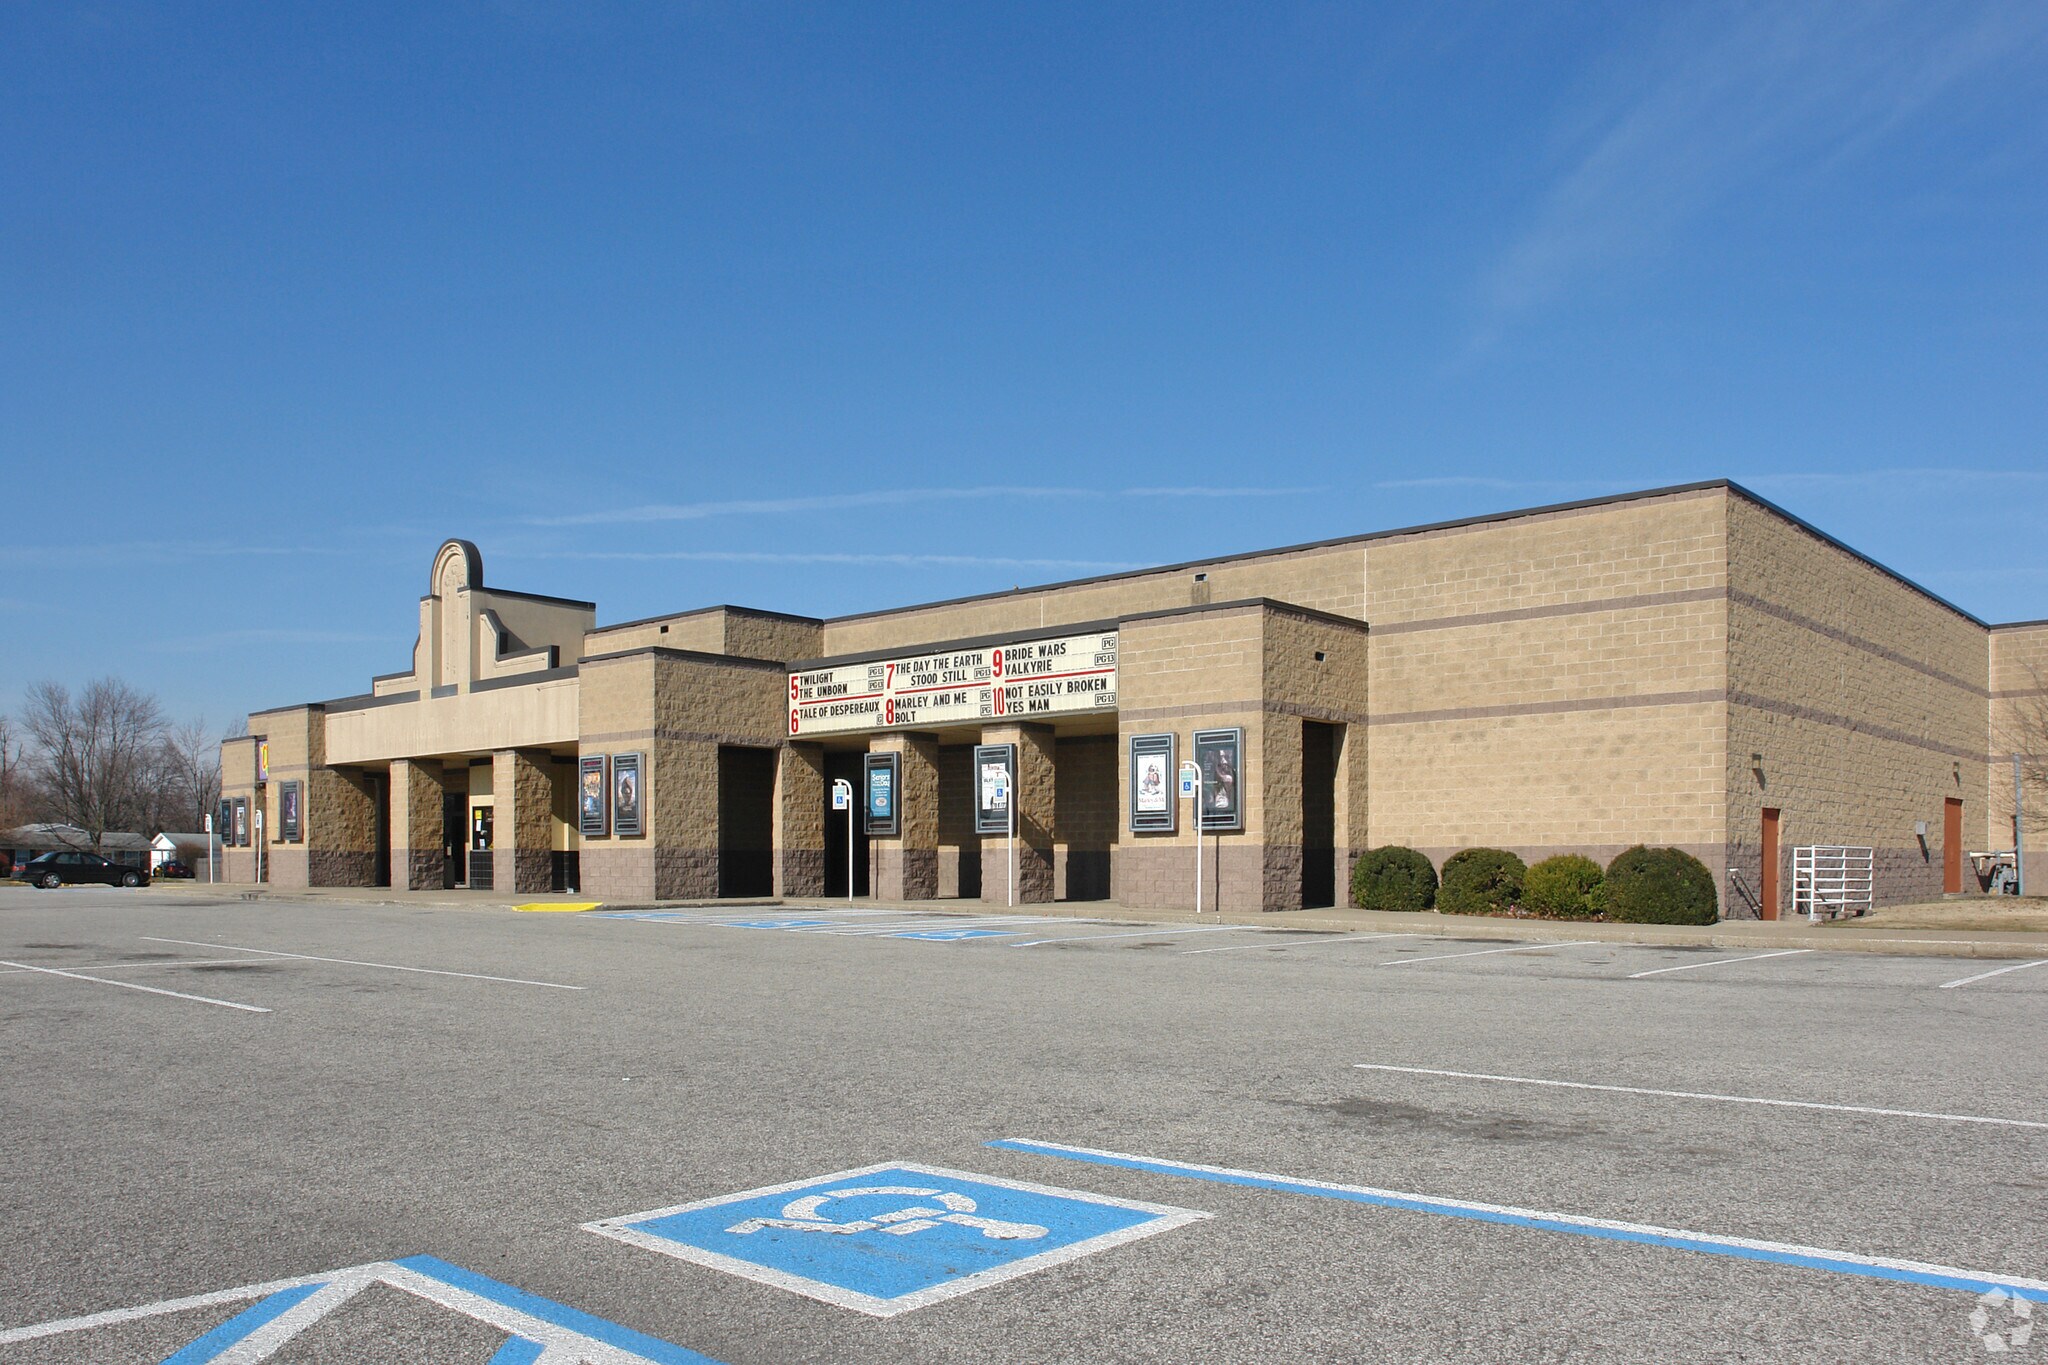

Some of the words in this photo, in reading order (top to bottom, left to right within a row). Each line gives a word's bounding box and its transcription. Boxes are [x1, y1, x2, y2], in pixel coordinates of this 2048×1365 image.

[1103, 639, 1114, 648] PG
[886, 663, 895, 689] 7
[896, 662, 911, 674] THE
[913, 660, 930, 672] DAY
[933, 658, 949, 670] THE
[954, 653, 983, 667] EARTH
[993, 649, 1003, 678] 9
[1005, 647, 1033, 661] BRIDE
[1038, 642, 1067, 657] WARS
[1005, 659, 1052, 675] VALKYRIE
[791, 676, 799, 700] 5
[799, 672, 834, 686] TWILIGHT
[911, 673, 938, 686] STOOD
[942, 670, 967, 682] STILL
[799, 688, 813, 699] THE
[817, 683, 848, 697] UNBORN
[992, 687, 1005, 715] 10
[1005, 686, 1023, 699] NOT
[1028, 682, 1063, 697] EASILY
[1067, 678, 1107, 693] BROKEN
[791, 709, 799, 733] 6
[799, 707, 817, 719] TALE
[819, 706, 828, 717] OF
[830, 701, 880, 715] DESPEREAUX
[886, 698, 895, 724] 8
[895, 696, 929, 710] MARLEY
[933, 694, 950, 707] AND
[954, 692, 967, 704] ME
[895, 711, 916, 723] BOLT
[1006, 701, 1024, 714] YES
[1029, 699, 1050, 712] MAN
